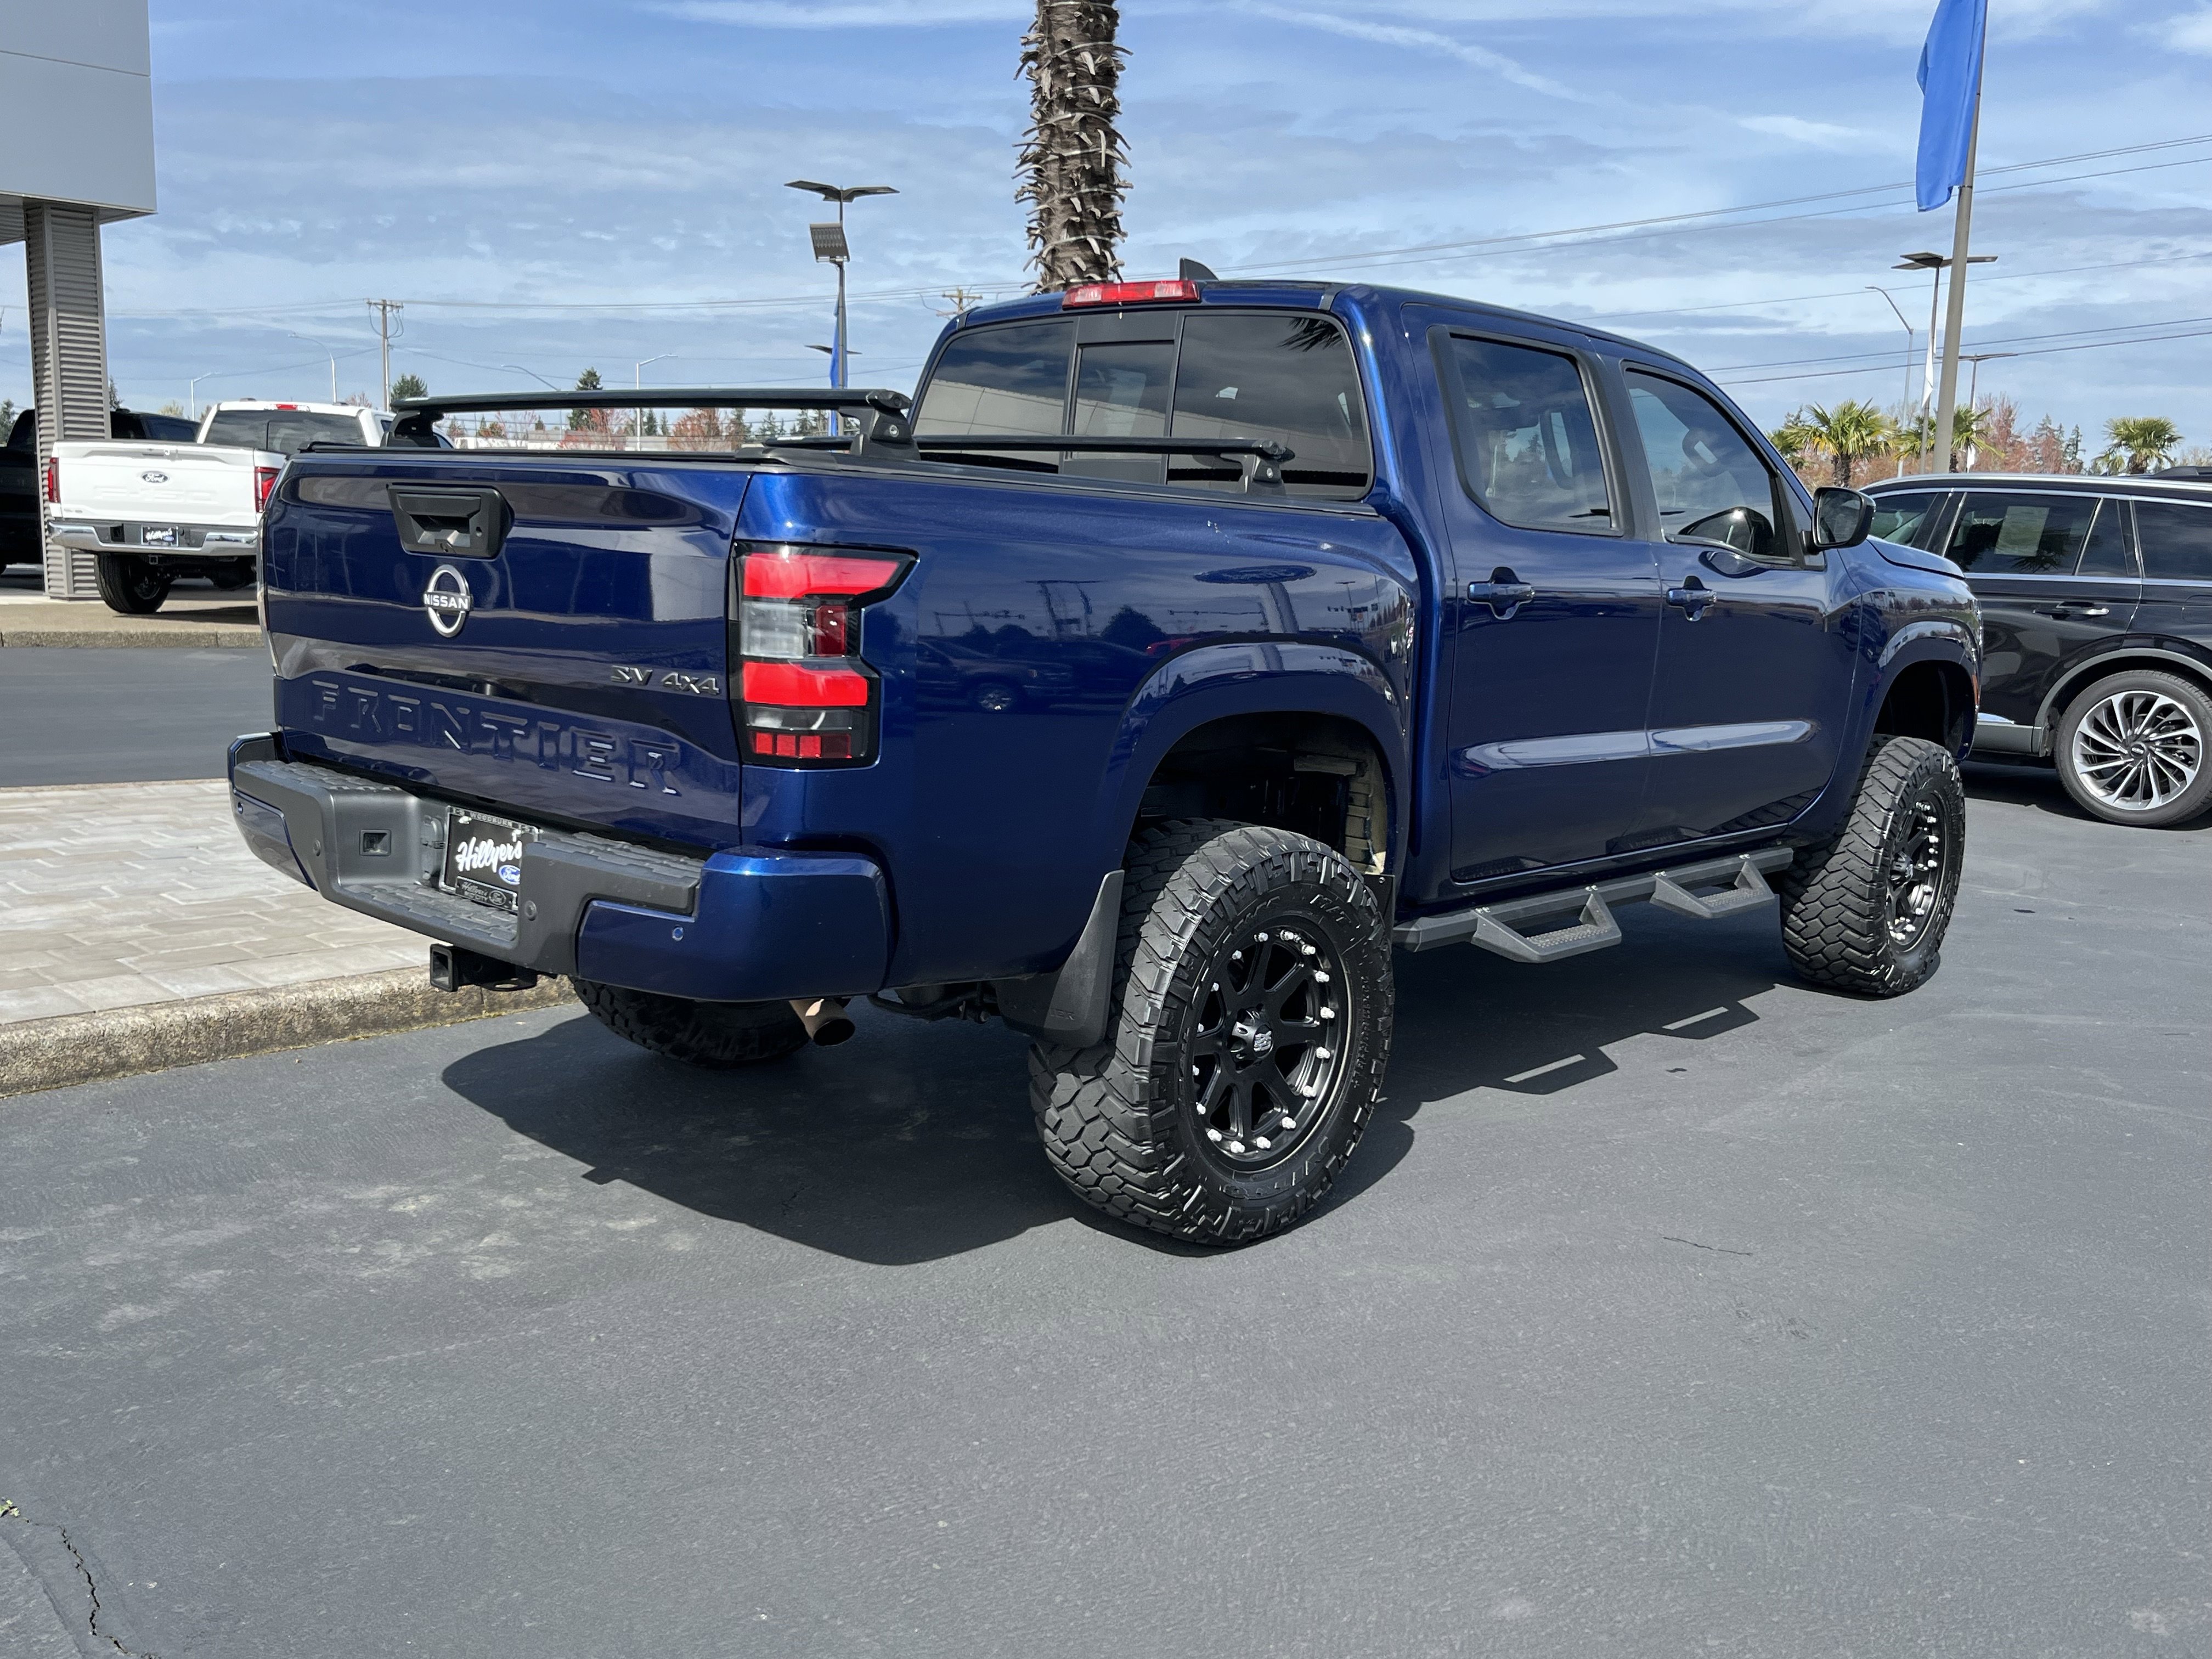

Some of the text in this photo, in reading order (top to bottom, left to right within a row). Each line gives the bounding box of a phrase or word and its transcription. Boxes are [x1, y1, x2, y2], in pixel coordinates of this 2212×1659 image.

[145, 473, 164, 482] Ford
[424, 594, 468, 609] NISSAN
[611, 665, 653, 685] SV
[312, 680, 681, 796] FRONTIER
[470, 811, 512, 827] WOODBURN
[455, 836, 522, 873] Hillyer's
